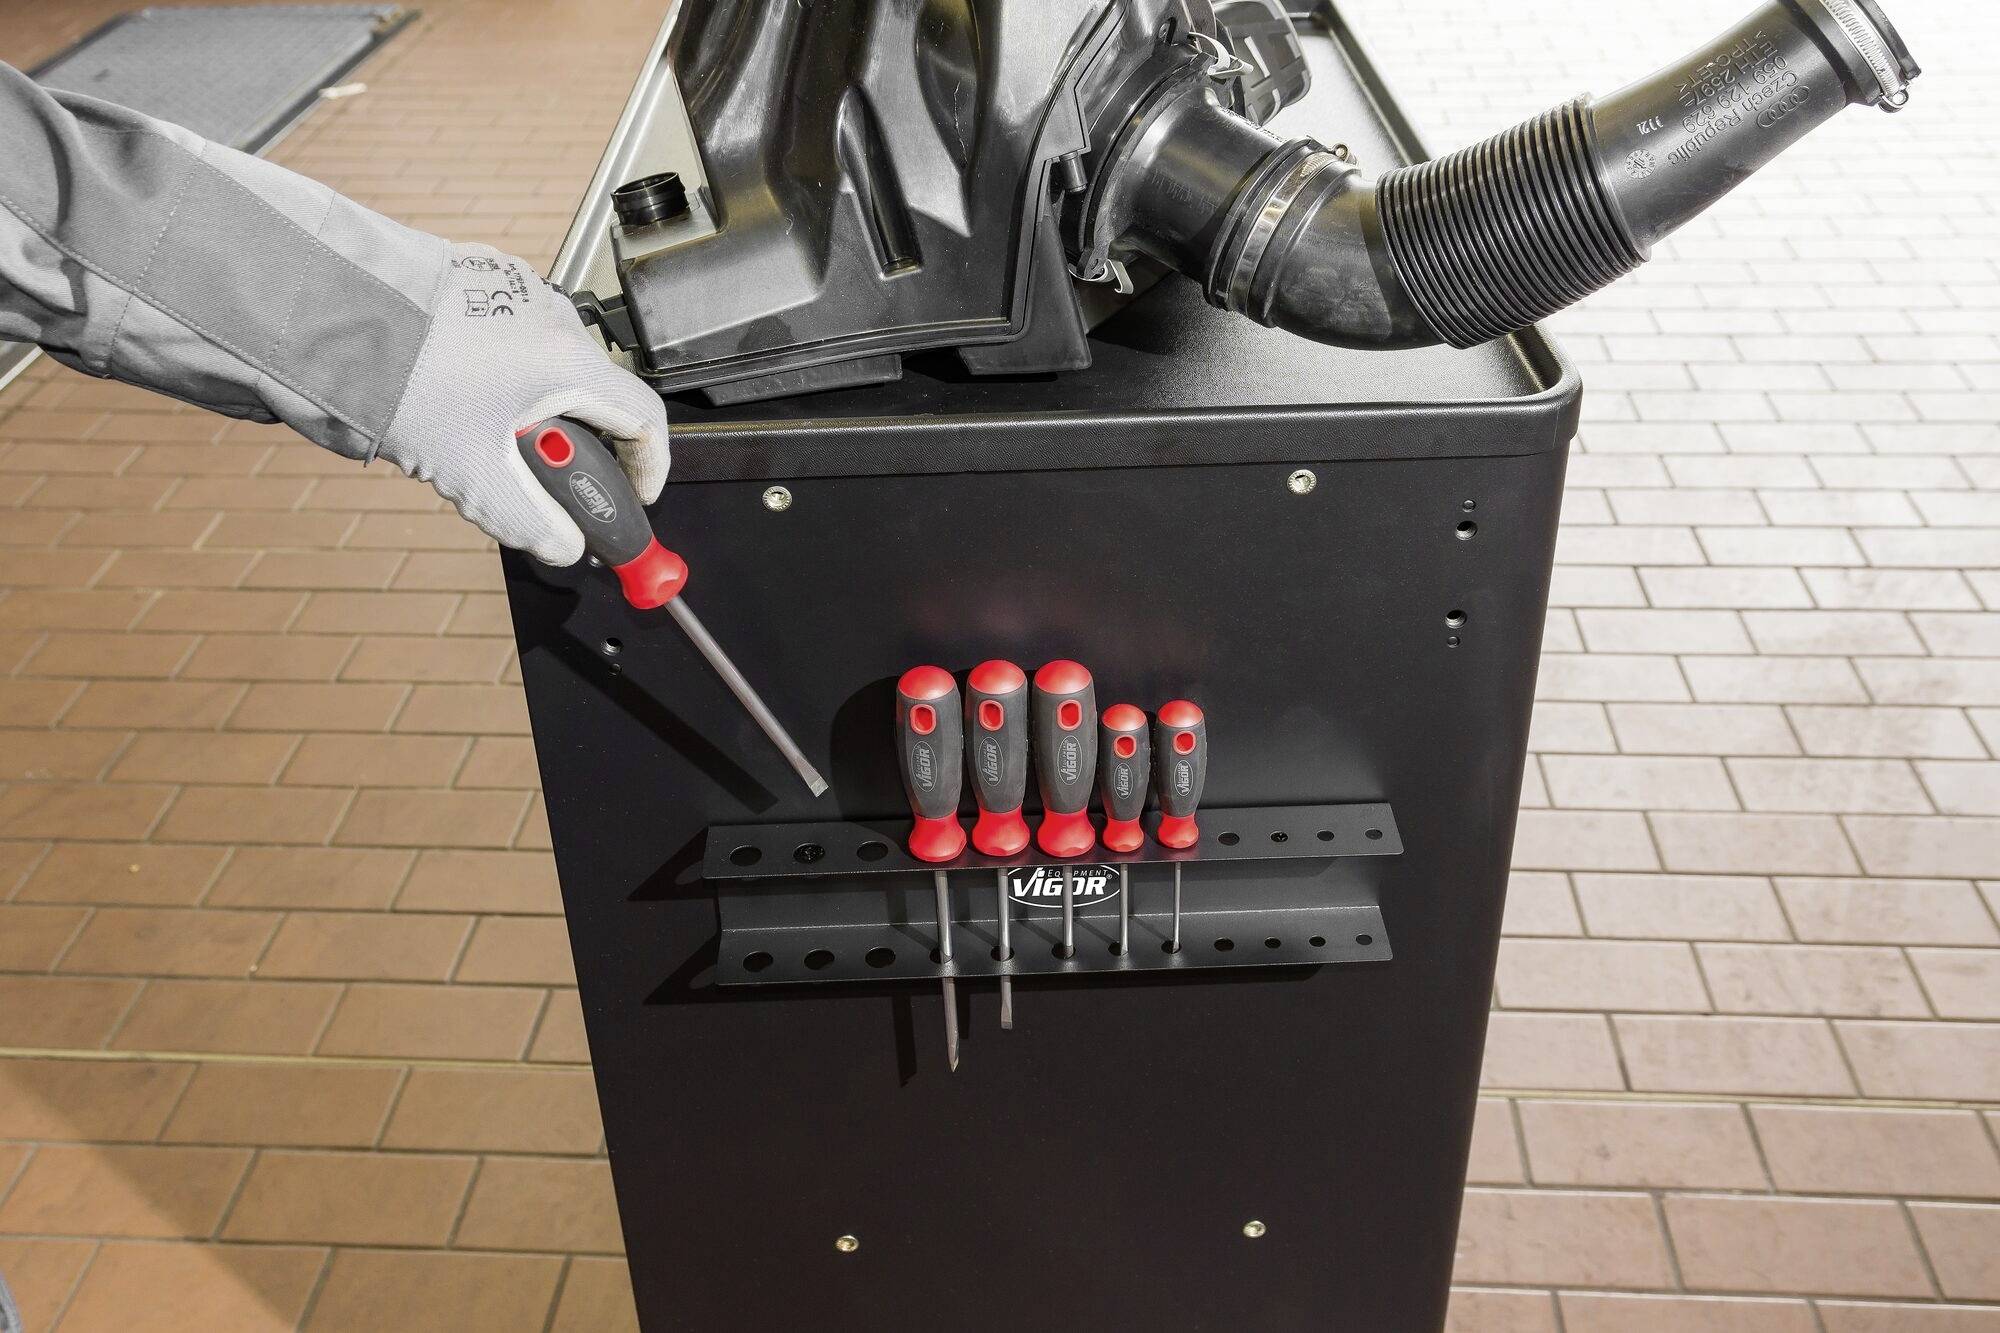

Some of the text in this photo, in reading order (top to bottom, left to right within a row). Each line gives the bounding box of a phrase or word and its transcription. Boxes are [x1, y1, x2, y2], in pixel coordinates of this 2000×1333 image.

[1734, 39, 1779, 75] ETH
[1682, 55, 1788, 133] 059 129 629
[1740, 70, 1798, 112] Czech
[1667, 108, 1742, 165] Republic
[1047, 868, 1108, 878] EQPMENT
